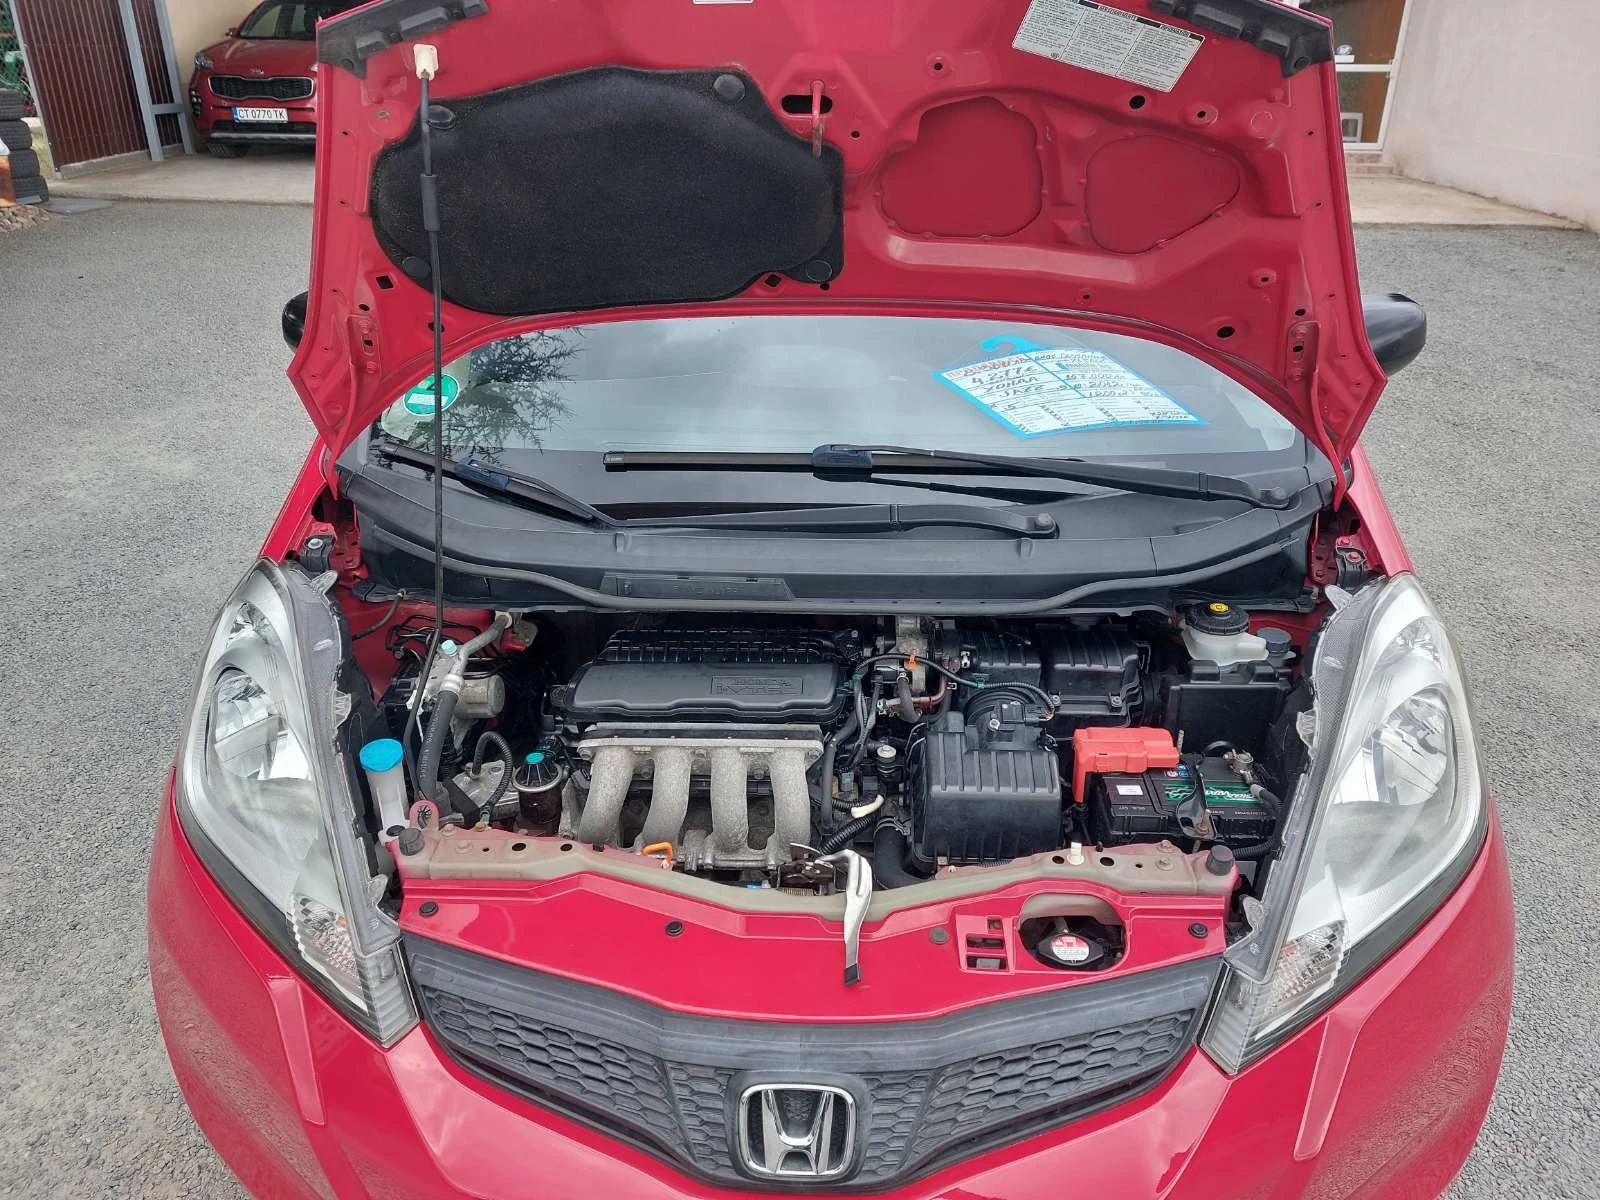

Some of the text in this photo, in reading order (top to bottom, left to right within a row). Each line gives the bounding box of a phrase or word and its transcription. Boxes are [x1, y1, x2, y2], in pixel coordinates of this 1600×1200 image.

[238, 109, 285, 119] CT 0770 TK
